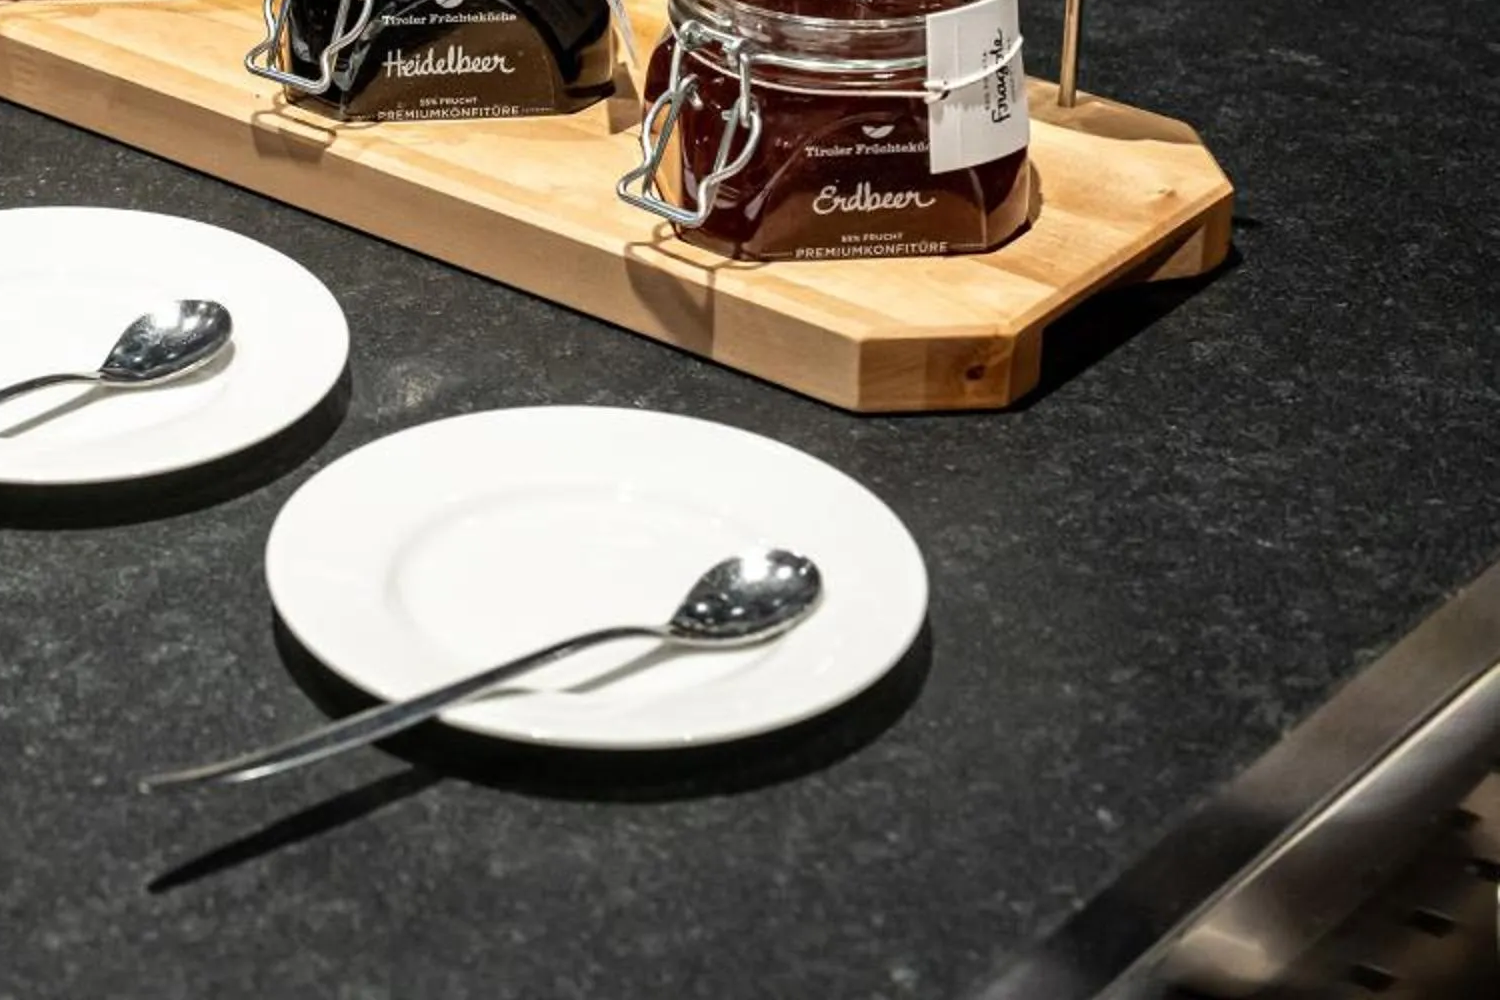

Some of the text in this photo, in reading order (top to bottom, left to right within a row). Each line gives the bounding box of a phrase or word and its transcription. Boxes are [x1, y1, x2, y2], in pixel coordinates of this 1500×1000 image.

[381, 14, 427, 25] Tiroler
[382, 45, 516, 78] Heidelbeer
[439, 96, 477, 106] FRUCHT
[377, 104, 520, 121] PREMIUMKONFITÜRE
[804, 146, 853, 158] Tiroler
[812, 181, 936, 215] Erdbeer
[862, 232, 903, 243] FRUCHT
[795, 241, 949, 259] PREMIUMKONFITÜRE
